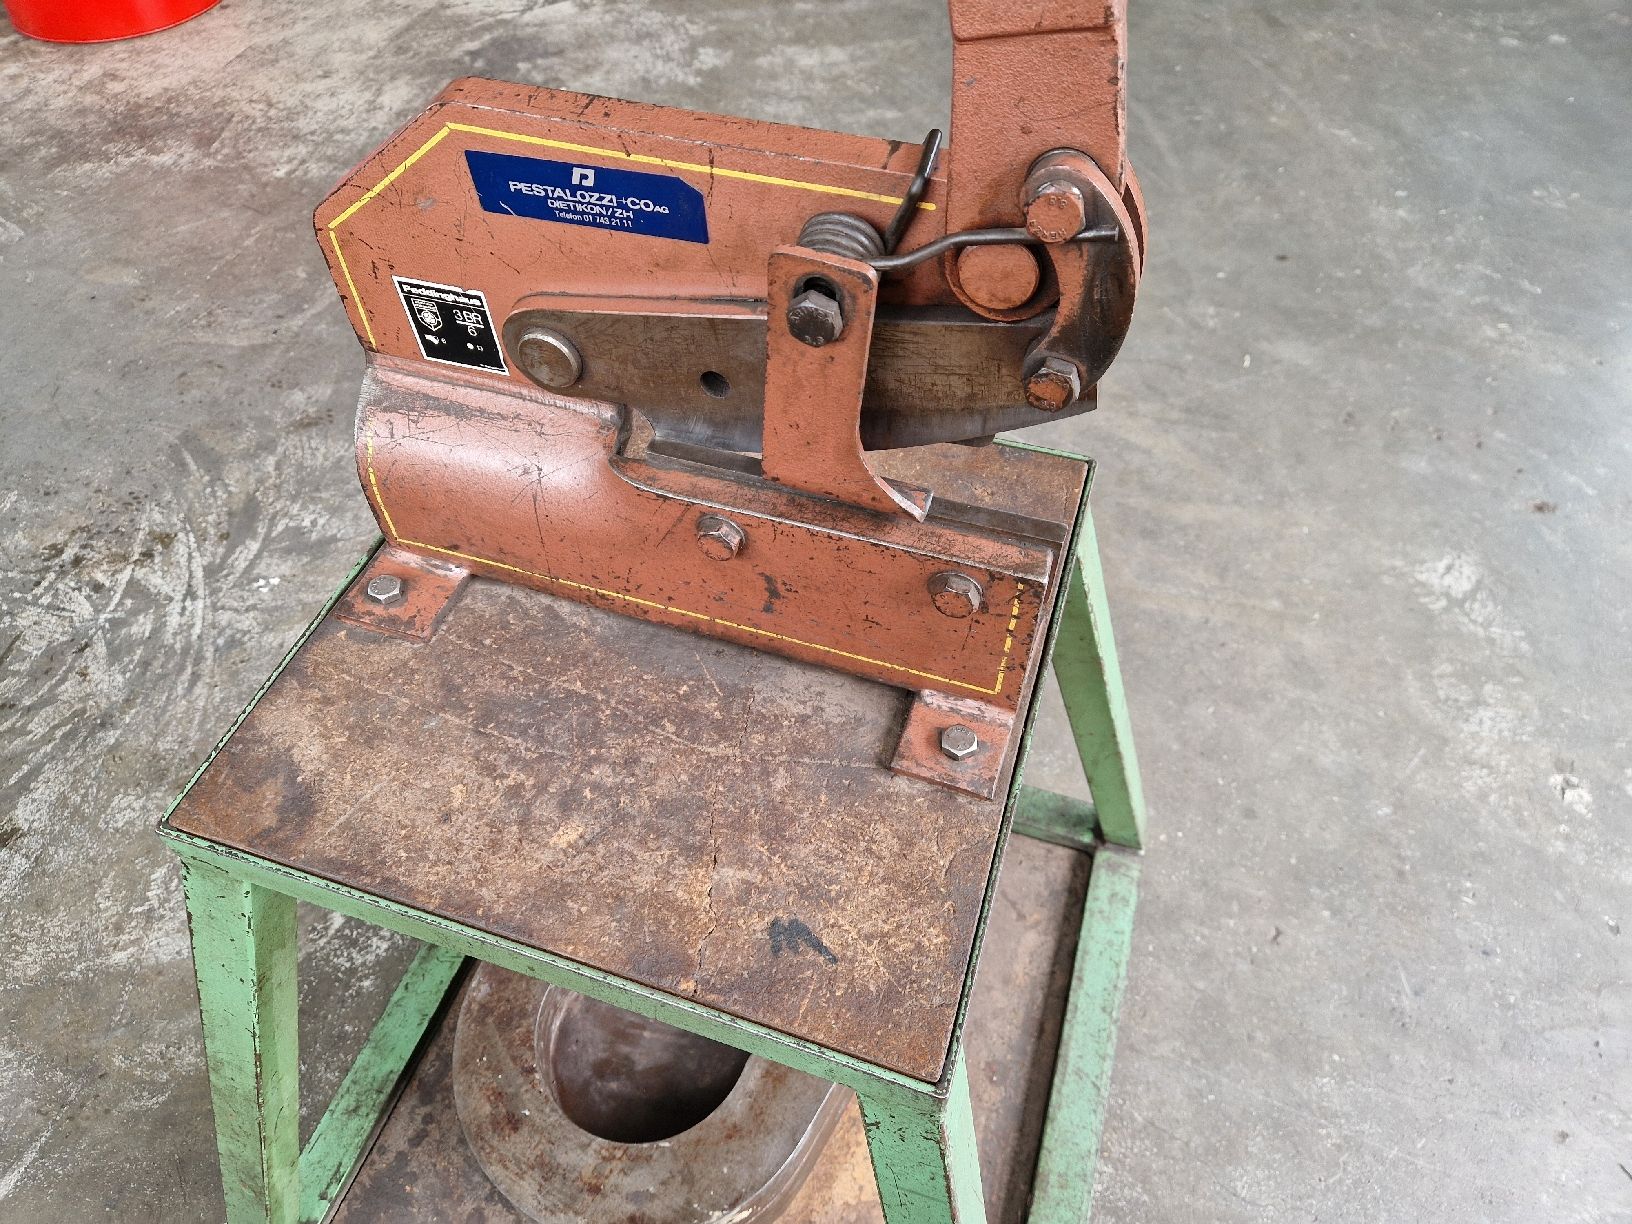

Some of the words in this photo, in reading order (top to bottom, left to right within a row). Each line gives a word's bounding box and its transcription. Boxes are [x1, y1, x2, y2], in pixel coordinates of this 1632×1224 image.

[547, 199, 633, 218] DIETIKON/ZH
[554, 210, 583, 221] Telefon
[583, 214, 593, 223] 01
[595, 216, 610, 225] 743
[611, 218, 620, 226] 21
